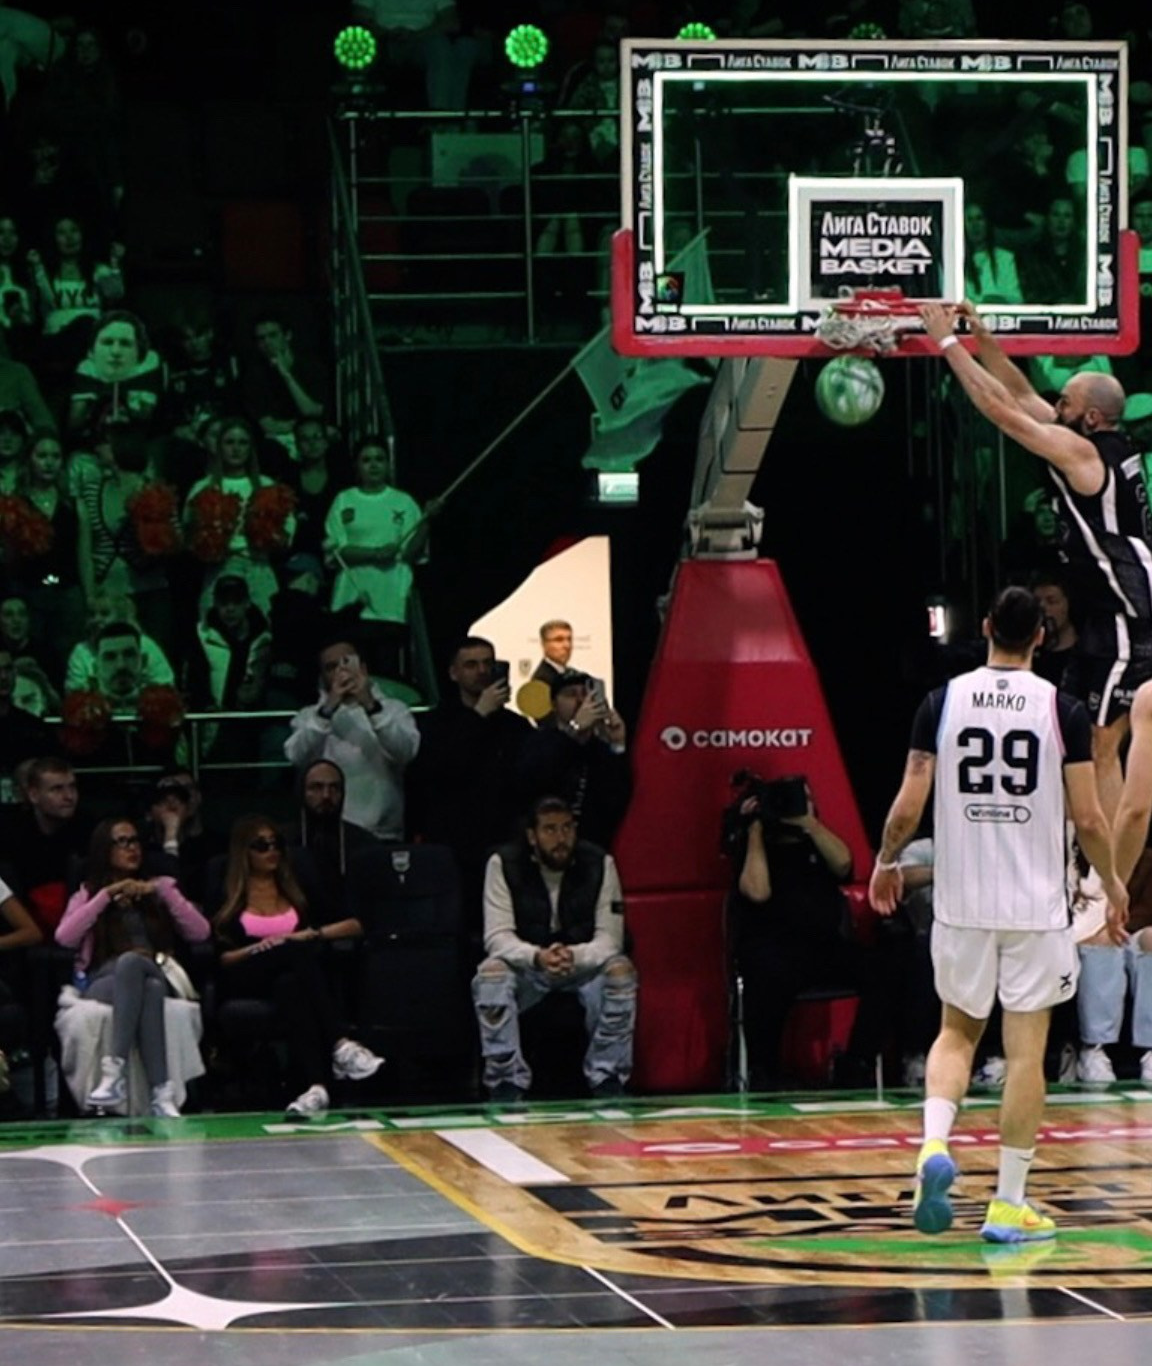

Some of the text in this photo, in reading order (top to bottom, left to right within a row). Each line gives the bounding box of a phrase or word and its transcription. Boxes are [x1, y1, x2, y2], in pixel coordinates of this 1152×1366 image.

[820, 237, 932, 257] MEDIA
[820, 259, 932, 274] BASKET
[972, 691, 1026, 712] MARKO
[957, 726, 1040, 796] 29
